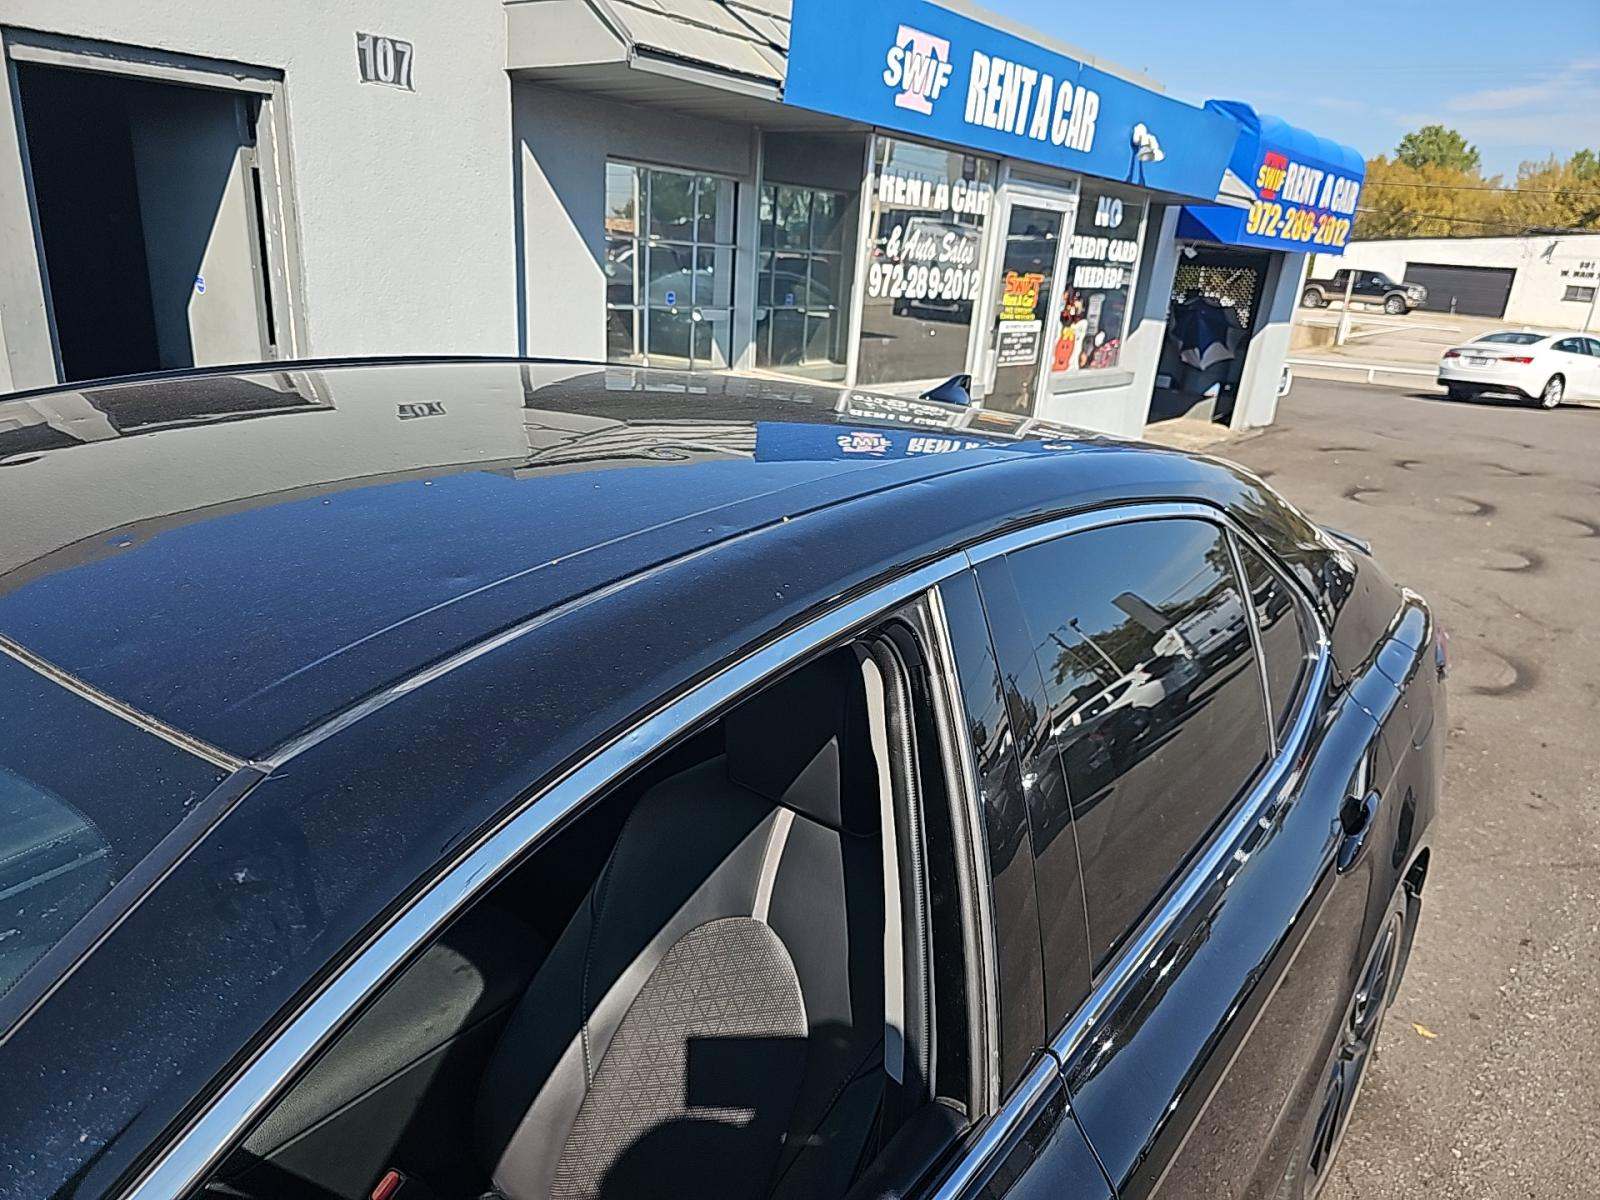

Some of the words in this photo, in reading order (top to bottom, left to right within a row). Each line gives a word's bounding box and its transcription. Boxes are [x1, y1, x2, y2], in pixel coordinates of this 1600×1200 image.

[357, 36, 411, 88] 107
[964, 51, 1038, 135] RENT
[1028, 74, 1054, 142] A
[1051, 80, 1100, 153] CAR
[879, 168, 932, 208] RENT
[933, 176, 949, 211] A
[951, 178, 990, 216] CAR
[1094, 195, 1123, 228] NO
[1282, 161, 1325, 207] RENT
[1318, 174, 1336, 209] A
[1331, 177, 1360, 215] CAR
[886, 225, 902, 259] &
[900, 229, 937, 262] Auto
[939, 231, 974, 265] Sales
[1246, 200, 1351, 248] 972-289-2012
[1108, 239, 1139, 262] CARD
[1073, 265, 1124, 290] NEEDED!
